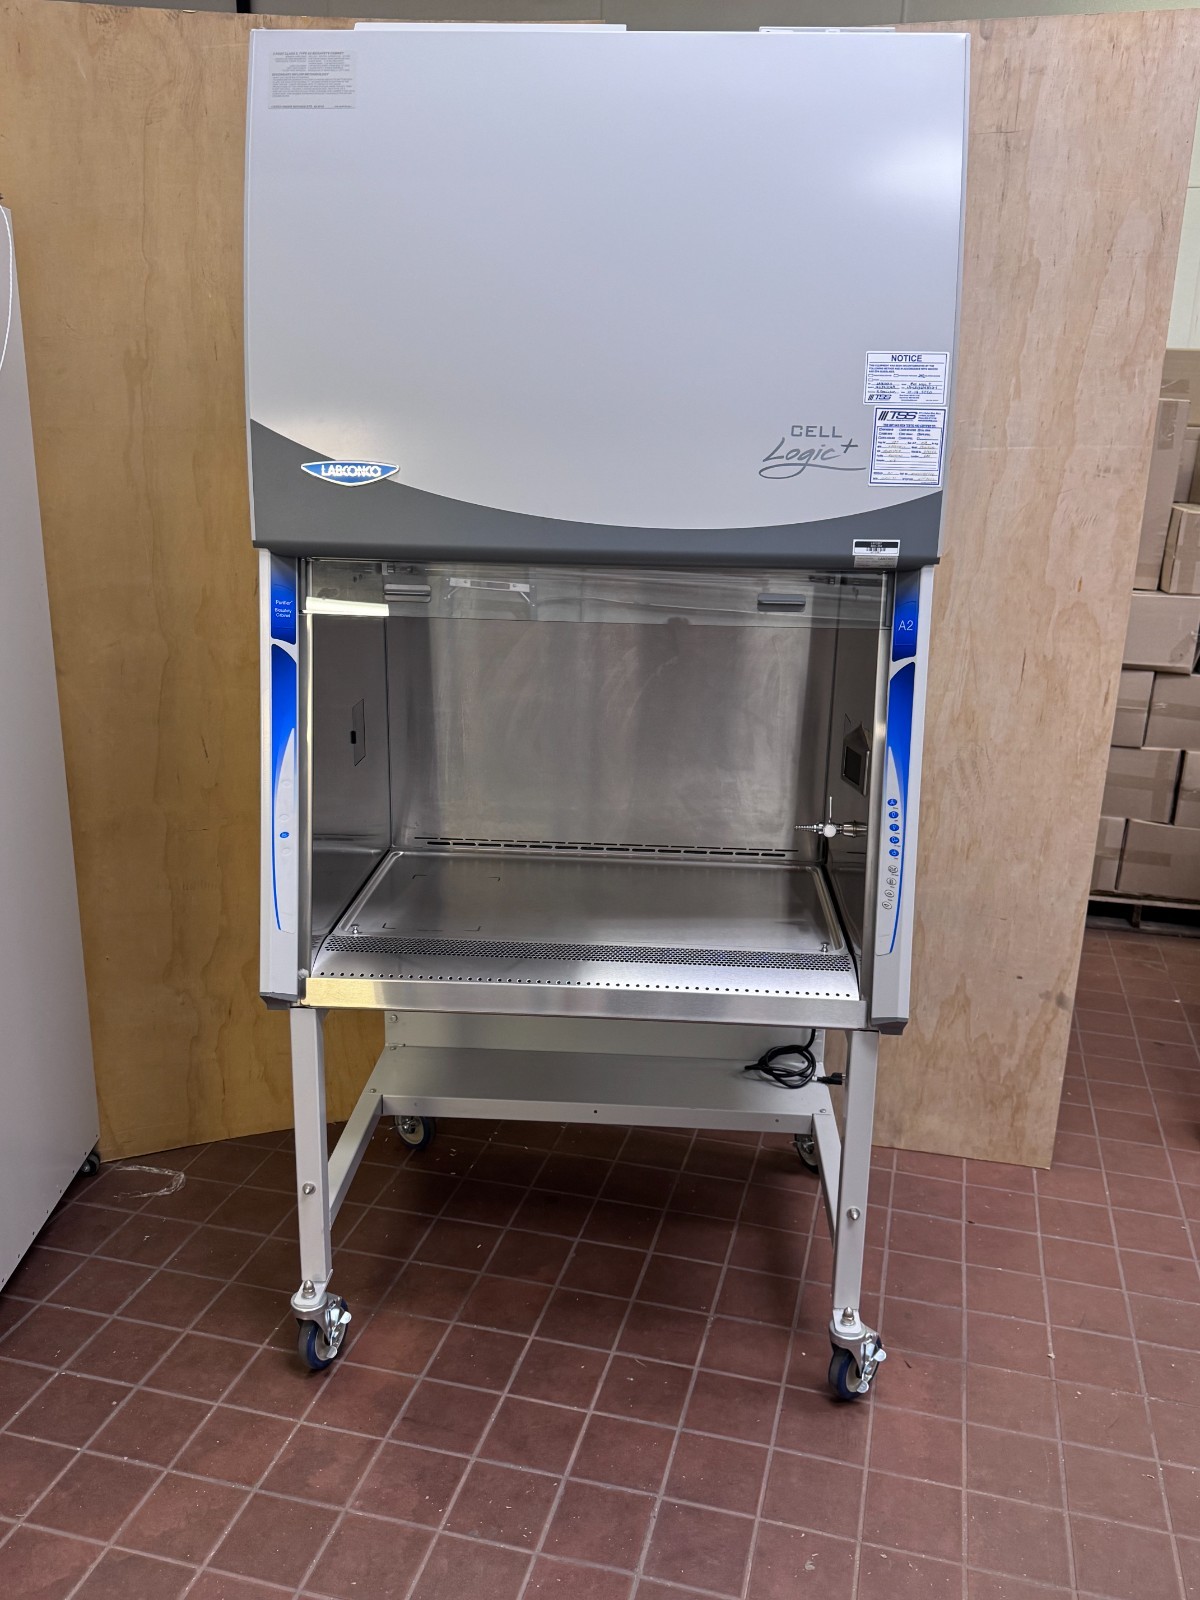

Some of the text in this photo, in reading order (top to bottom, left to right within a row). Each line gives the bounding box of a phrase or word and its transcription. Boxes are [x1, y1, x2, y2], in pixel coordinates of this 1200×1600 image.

[891, 354, 922, 362] NOTICE
[890, 411, 918, 420] TSS
[791, 425, 843, 438] CELL
[321, 464, 382, 478] LABCONCO
[898, 619, 914, 631] A2
